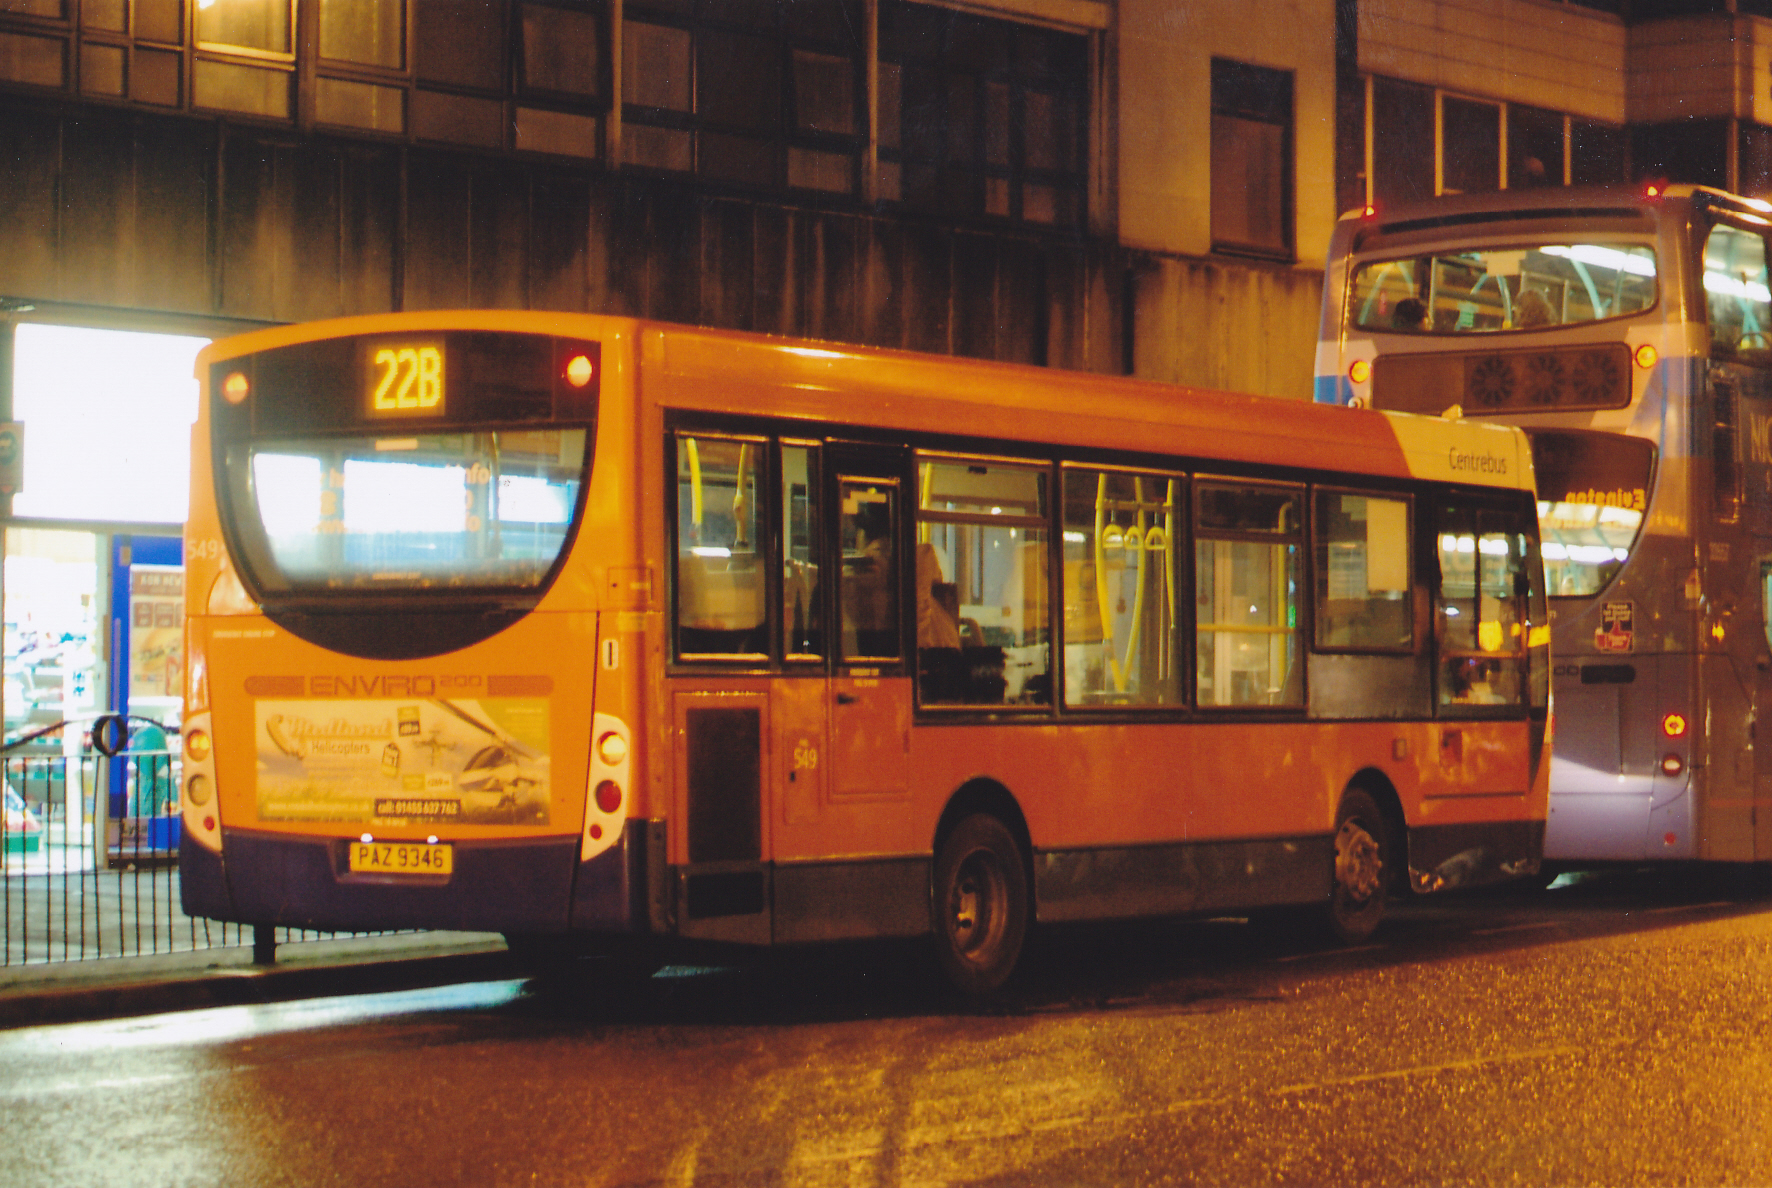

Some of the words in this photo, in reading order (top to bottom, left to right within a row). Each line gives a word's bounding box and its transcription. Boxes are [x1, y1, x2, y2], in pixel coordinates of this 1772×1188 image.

[375, 347, 441, 409] 22B
[1449, 446, 1507, 475] Centrebus
[186, 538, 218, 559] 549
[310, 675, 436, 696] ENVIRO
[311, 740, 371, 756] Helicopters
[793, 747, 818, 769] 549
[359, 847, 392, 865] PAZ
[398, 848, 444, 868] 9346
